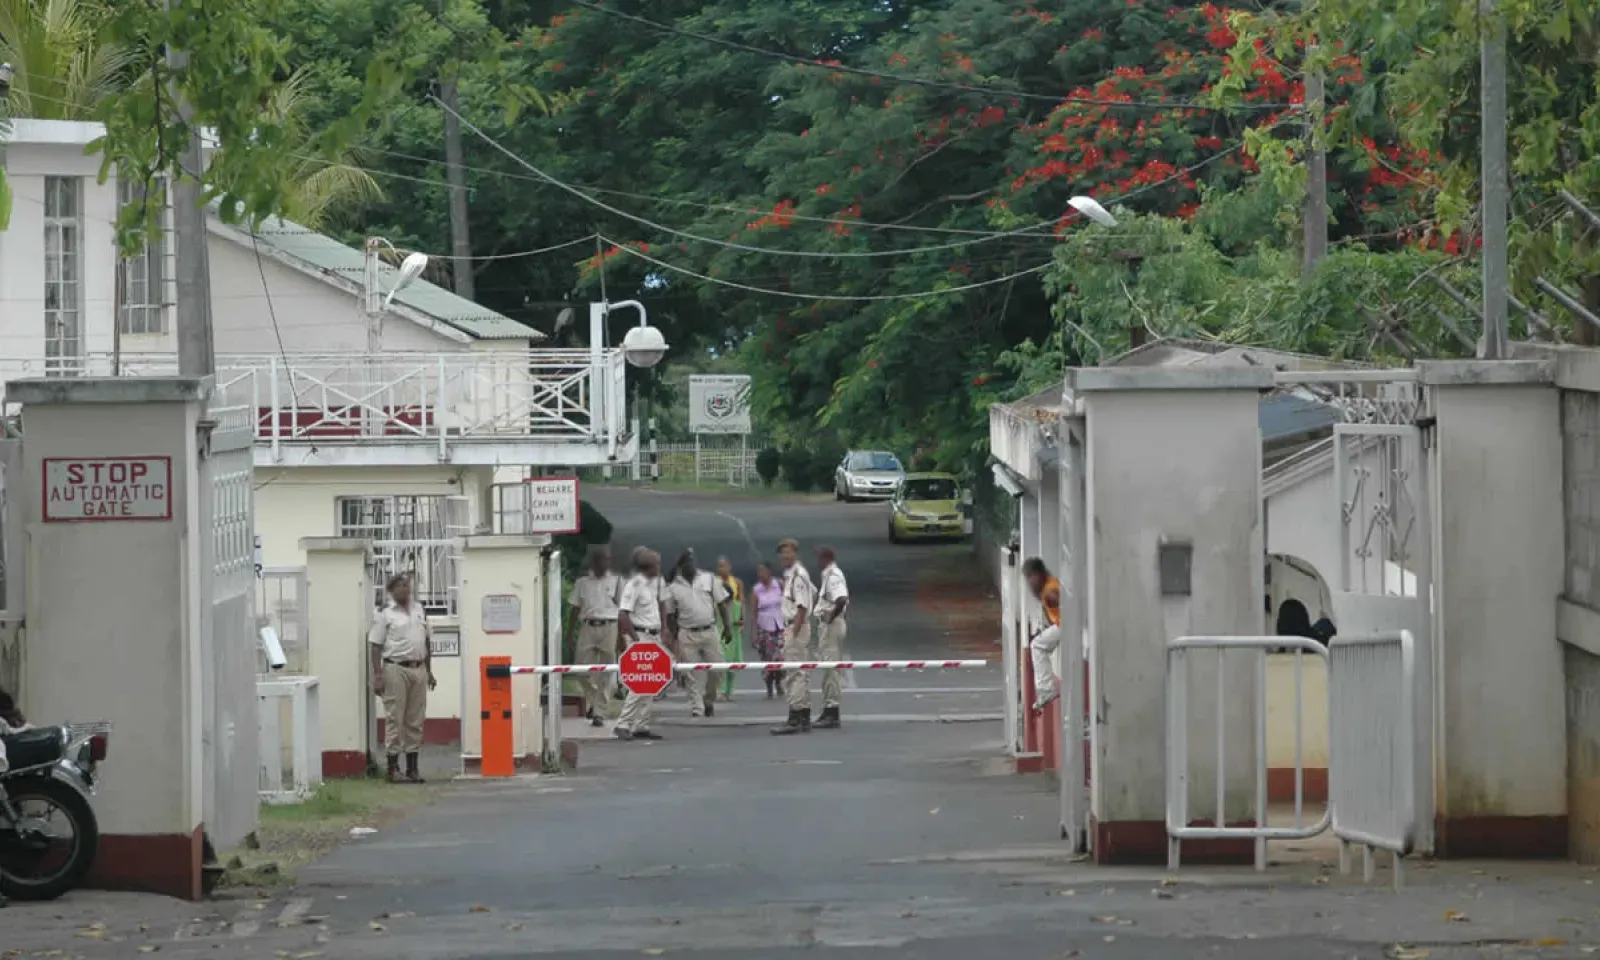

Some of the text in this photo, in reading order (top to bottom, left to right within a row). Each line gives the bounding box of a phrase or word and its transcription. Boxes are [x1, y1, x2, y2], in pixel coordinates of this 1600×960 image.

[67, 463, 148, 484] STOP
[50, 484, 164, 502] AUTOMATIC
[82, 501, 134, 516] GATE
[532, 513, 565, 521] ARRIER
[630, 651, 660, 661] STOP
[621, 672, 668, 682] CONTROL
